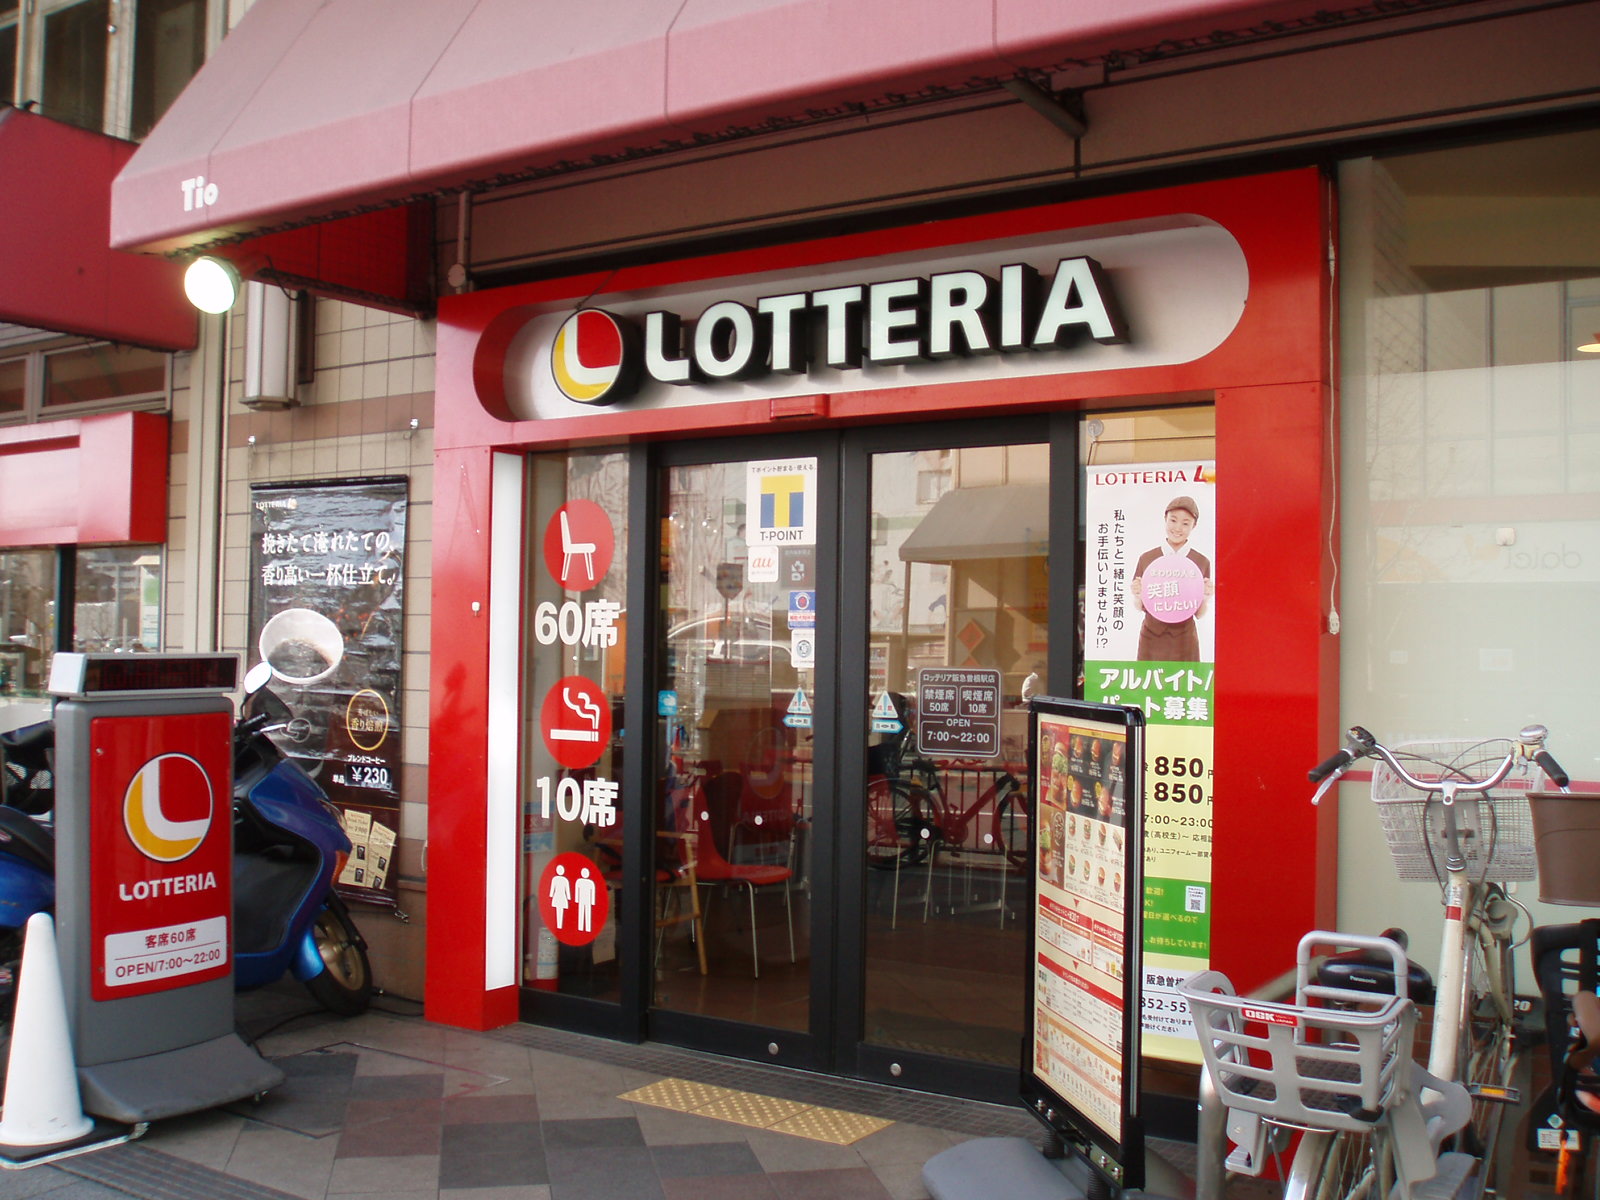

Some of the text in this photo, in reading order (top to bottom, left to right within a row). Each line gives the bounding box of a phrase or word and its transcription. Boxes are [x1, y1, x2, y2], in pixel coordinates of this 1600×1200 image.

[181, 176, 219, 212] Tio
[645, 257, 1120, 384] LOTTERIA
[1095, 470, 1187, 486] LOTTERIA
[760, 530, 804, 541] T-POINT
[752, 557, 774, 568] au
[1113, 509, 1125, 631] 私たちと一緒に笑顔の
[1096, 523, 1109, 649] お手伝いしませんか!?
[1148, 581, 1180, 599] 笑顔
[1154, 600, 1199, 612] にしたい!
[534, 598, 621, 648] 60席
[1099, 668, 1213, 692] アルバイト/
[924, 689, 955, 701] 禁煙席
[962, 690, 994, 702] 喫煙席
[929, 702, 950, 713] 50席
[968, 704, 988, 714] 10席
[946, 718, 971, 727] OPEN
[347, 754, 386, 765] ブレンドコーヒー
[351, 766, 388, 785] ¥230
[536, 776, 620, 828] 10席
[119, 871, 217, 901] LOTTERIA
[145, 928, 197, 949] 客席60席
